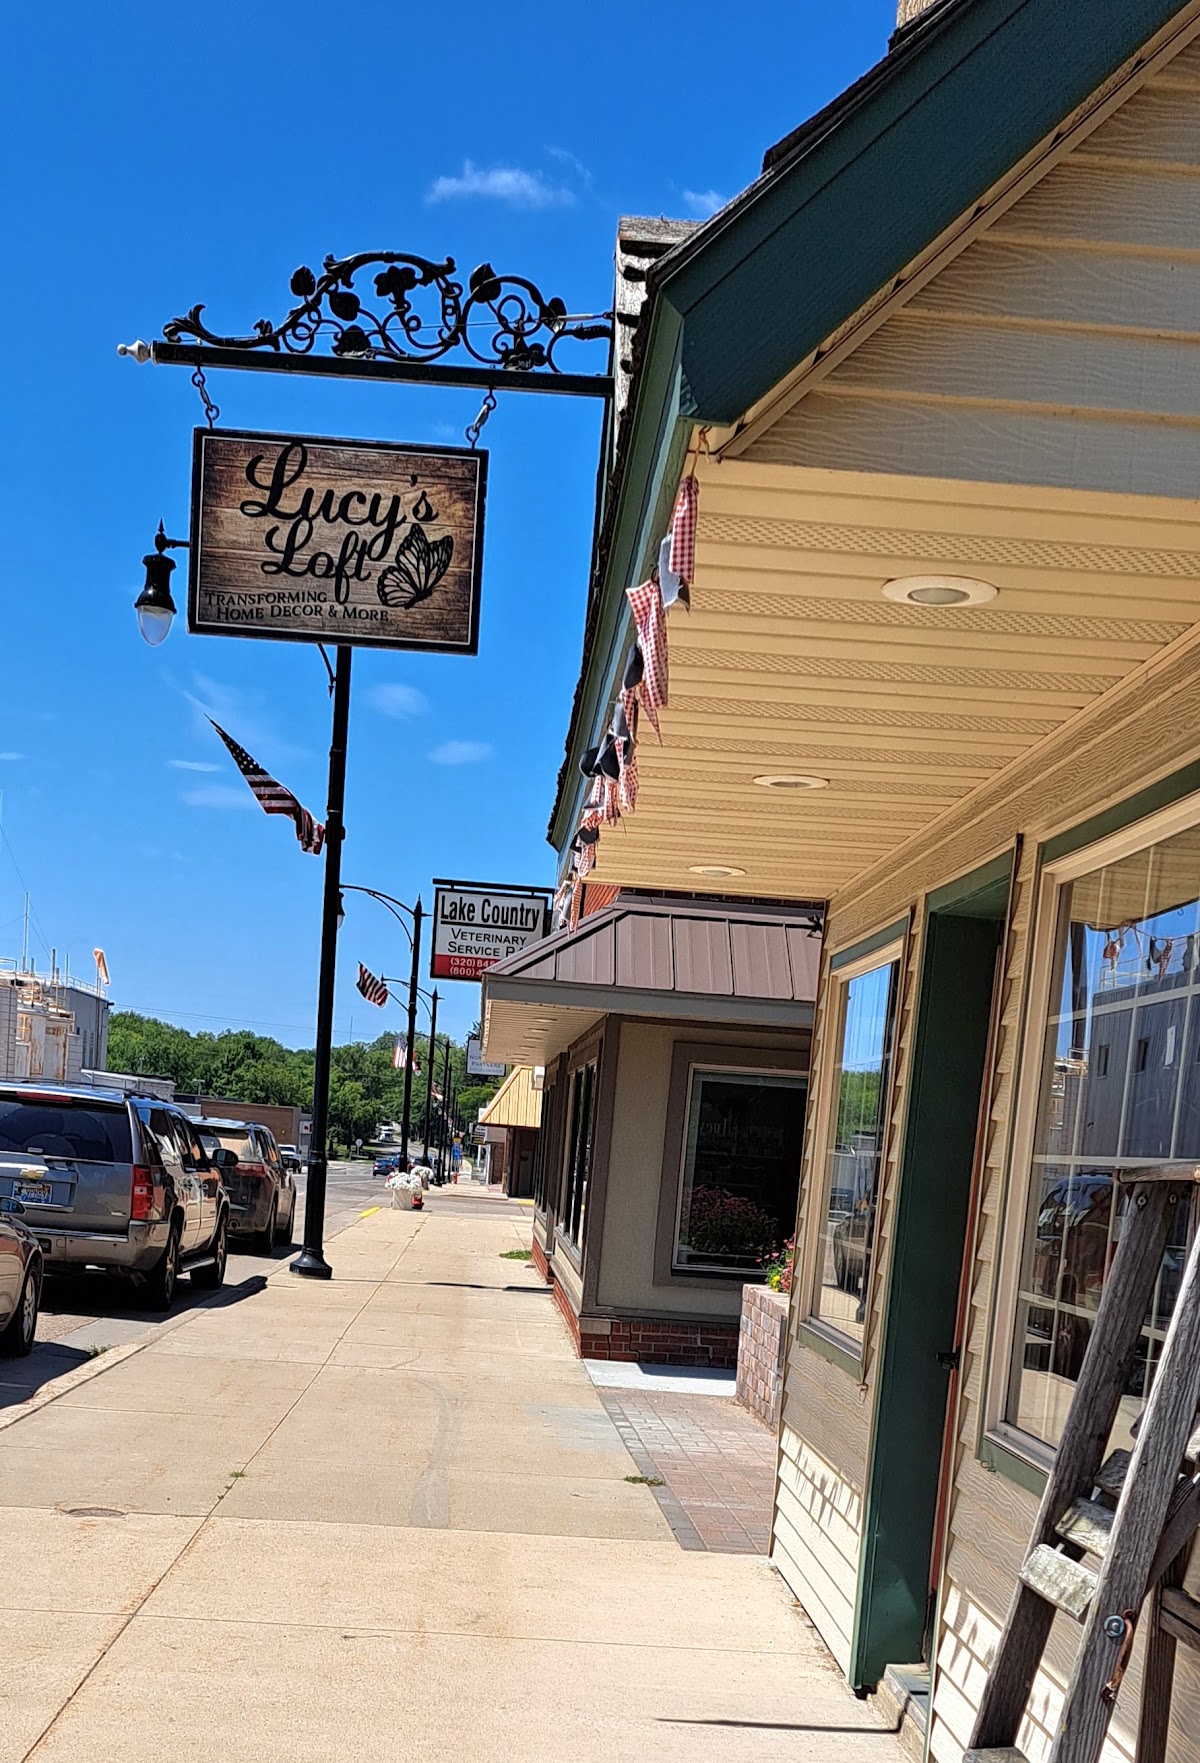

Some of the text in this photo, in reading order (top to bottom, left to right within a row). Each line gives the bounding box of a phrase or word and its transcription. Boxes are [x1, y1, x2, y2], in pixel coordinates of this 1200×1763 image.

[240, 441, 439, 561] Lucy's
[260, 519, 372, 605] Loft
[217, 604, 389, 621] HOME DECOR & MORE
[441, 895, 540, 931] Lake Country
[451, 928, 527, 946] VETERINARY
[447, 941, 500, 957] SERVICE
[450, 957, 475, 968] (320)
[450, 966, 475, 977] (800)
